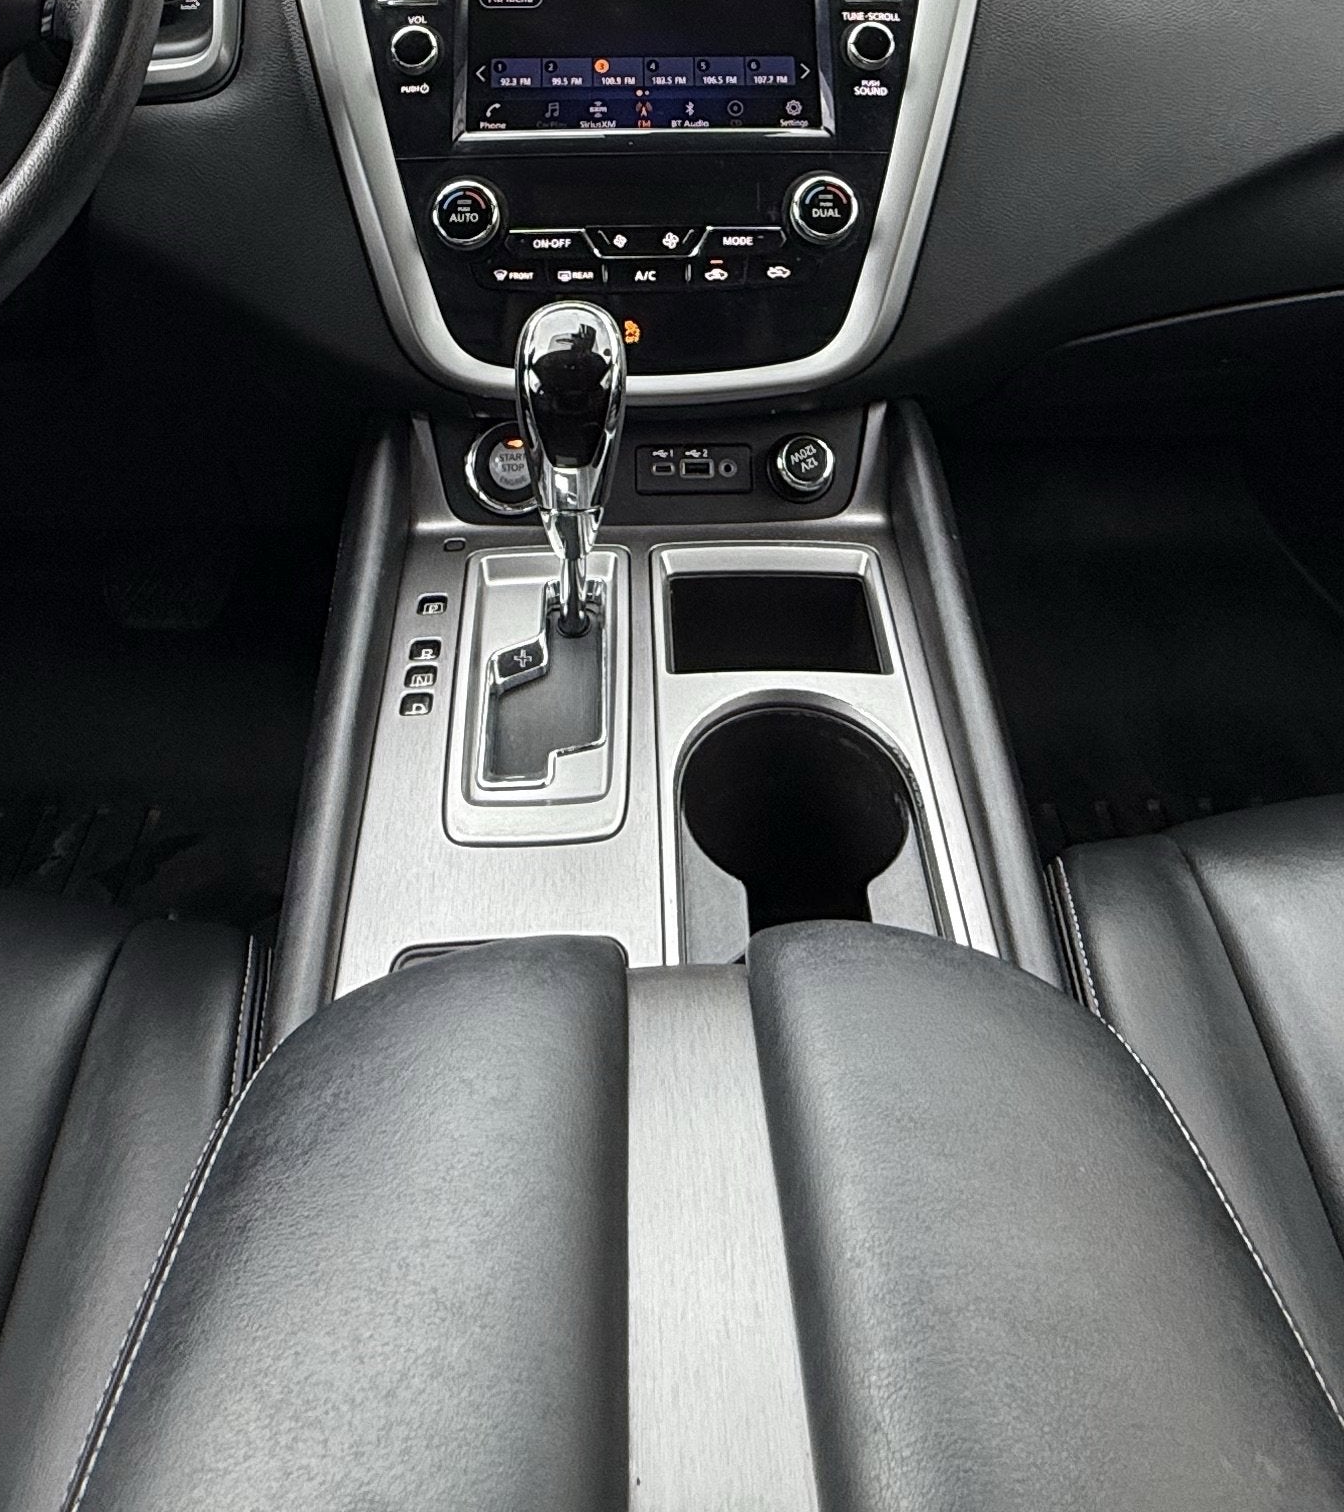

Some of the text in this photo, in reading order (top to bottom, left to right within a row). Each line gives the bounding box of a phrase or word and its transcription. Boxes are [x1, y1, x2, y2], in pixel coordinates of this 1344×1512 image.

[407, 15, 428, 24] VOL
[497, 63, 503, 71] 1
[548, 63, 554, 71] 2
[599, 62, 605, 71] 3
[650, 62, 656, 70] 4
[700, 62, 706, 70] 5
[751, 61, 757, 70] 6
[519, 77, 532, 86] FM
[570, 77, 583, 86] FM
[624, 77, 636, 85] FM
[674, 76, 687, 85] FM
[725, 76, 738, 85] FM
[776, 76, 788, 84] FM
[853, 86, 889, 96] SOUND
[479, 121, 507, 129] Phone
[579, 120, 617, 128] SiriusXM
[671, 120, 710, 128] BT Audio
[779, 119, 809, 128] Settings
[811, 207, 843, 218] DUAL
[448, 212, 479, 223] AUTO
[722, 236, 754, 246] MODE
[508, 271, 534, 280] FRONT
[572, 271, 594, 280] REAR
[634, 270, 657, 282] A/C
[702, 448, 708, 457] 2
[790, 444, 817, 466] 120W
[499, 453, 527, 462] START
[502, 464, 525, 472] STOP
[801, 457, 819, 473] 12V
